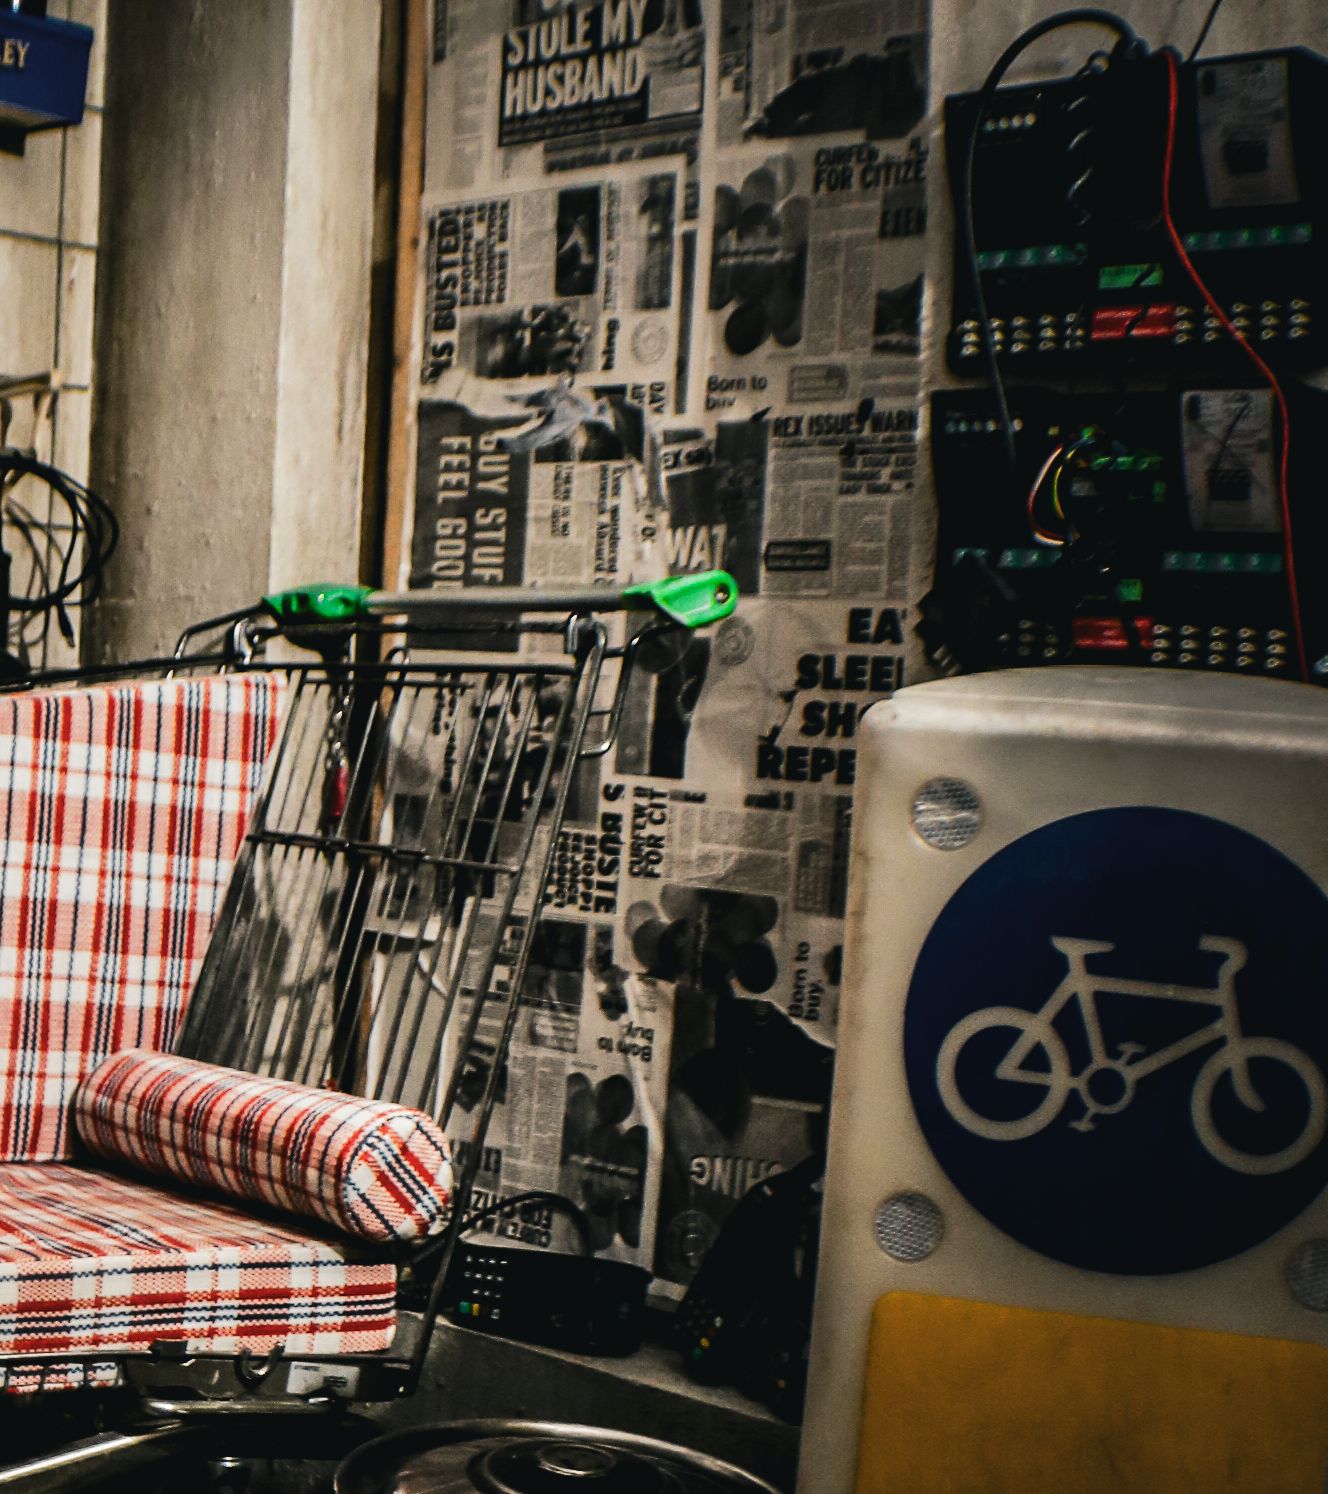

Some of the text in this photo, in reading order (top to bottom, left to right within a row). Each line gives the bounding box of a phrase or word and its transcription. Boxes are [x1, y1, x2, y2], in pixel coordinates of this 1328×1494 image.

[600, 0, 649, 48] MY
[503, 47, 647, 119] HUSBAND
[815, 165, 852, 194] FOR
[707, 374, 768, 391] Born to
[436, 434, 473, 507] FEEL
[847, 607, 909, 644] EA
[800, 700, 868, 739] SH
[643, 834, 665, 879] FOR
